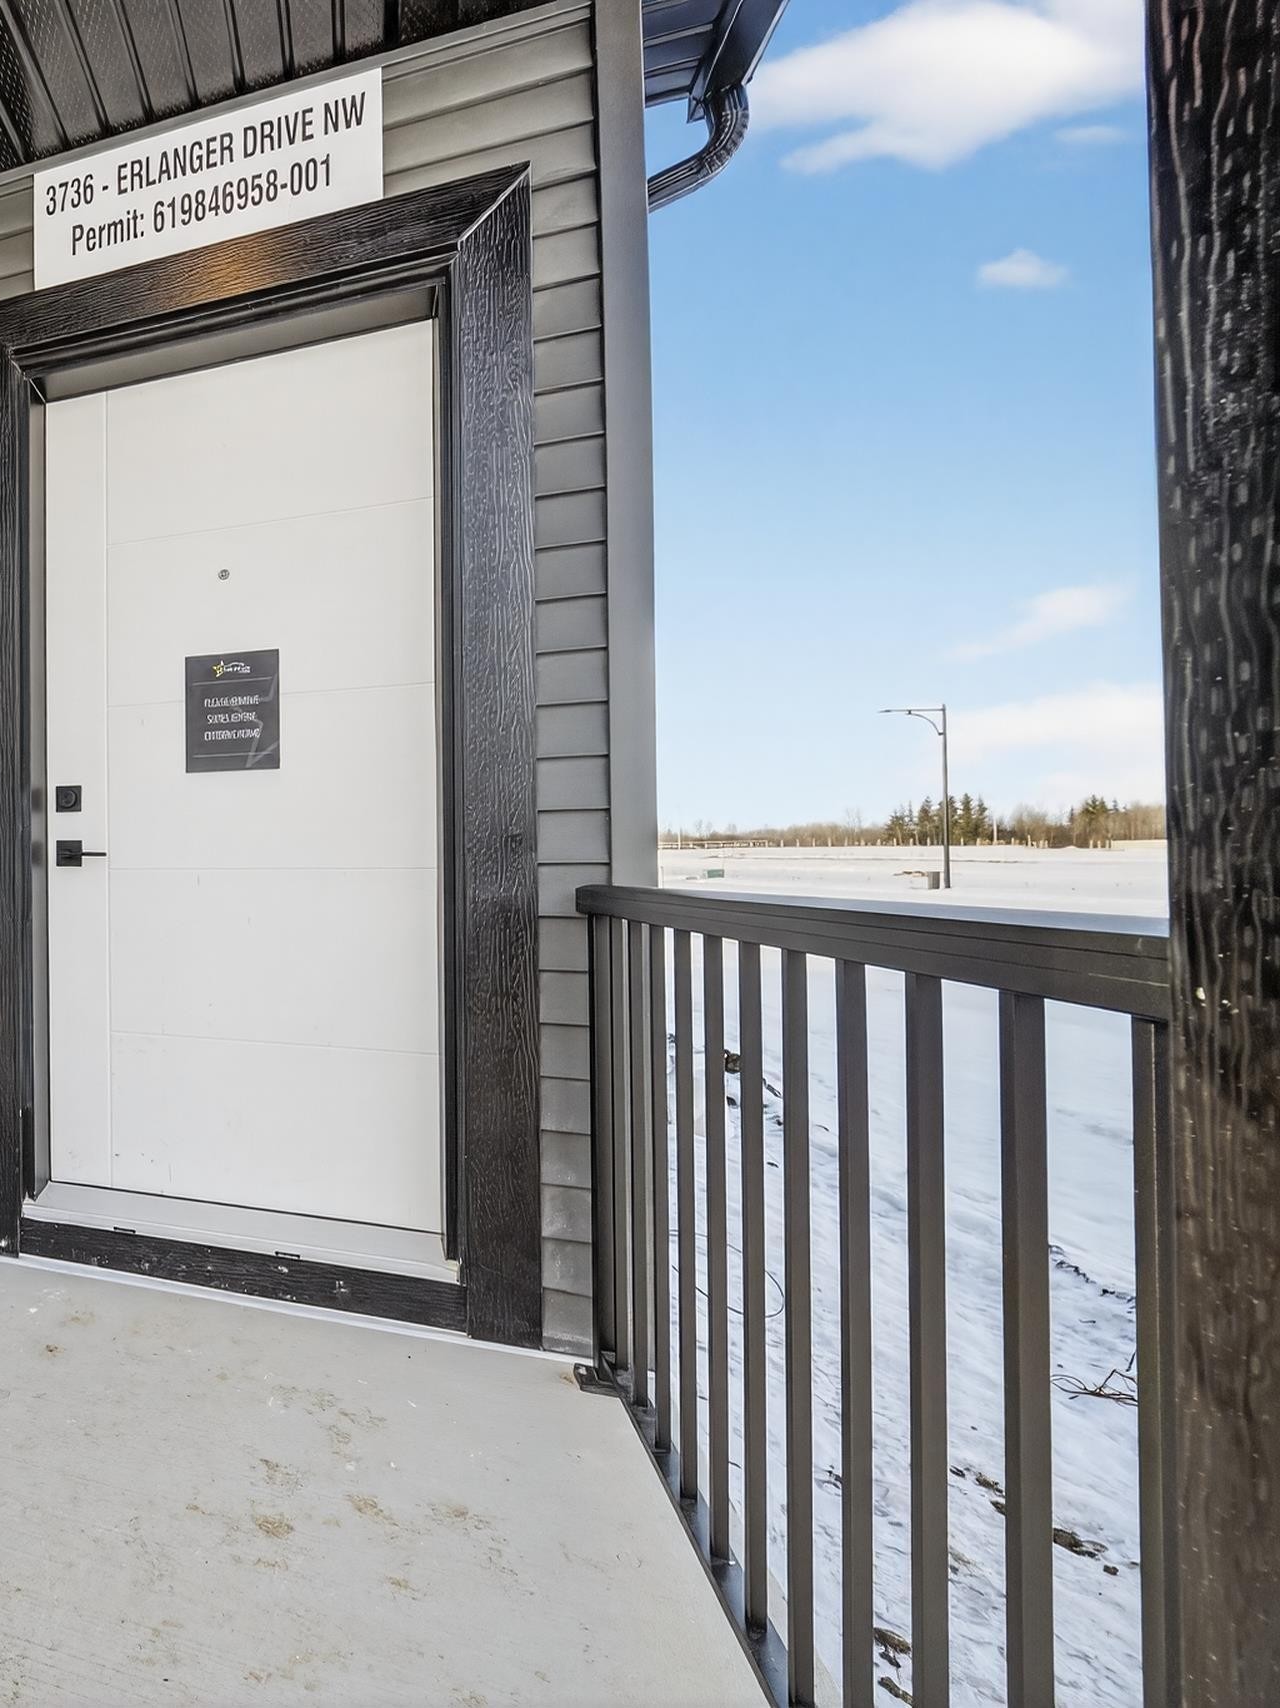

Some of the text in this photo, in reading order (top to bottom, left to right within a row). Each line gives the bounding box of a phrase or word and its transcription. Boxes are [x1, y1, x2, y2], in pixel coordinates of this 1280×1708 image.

[45, 173, 95, 217] 3736
[117, 131, 235, 196] ERLANGER
[243, 106, 314, 159] DRIVE
[323, 91, 367, 136] NW
[71, 153, 332, 256] Permit: 619846958-001
